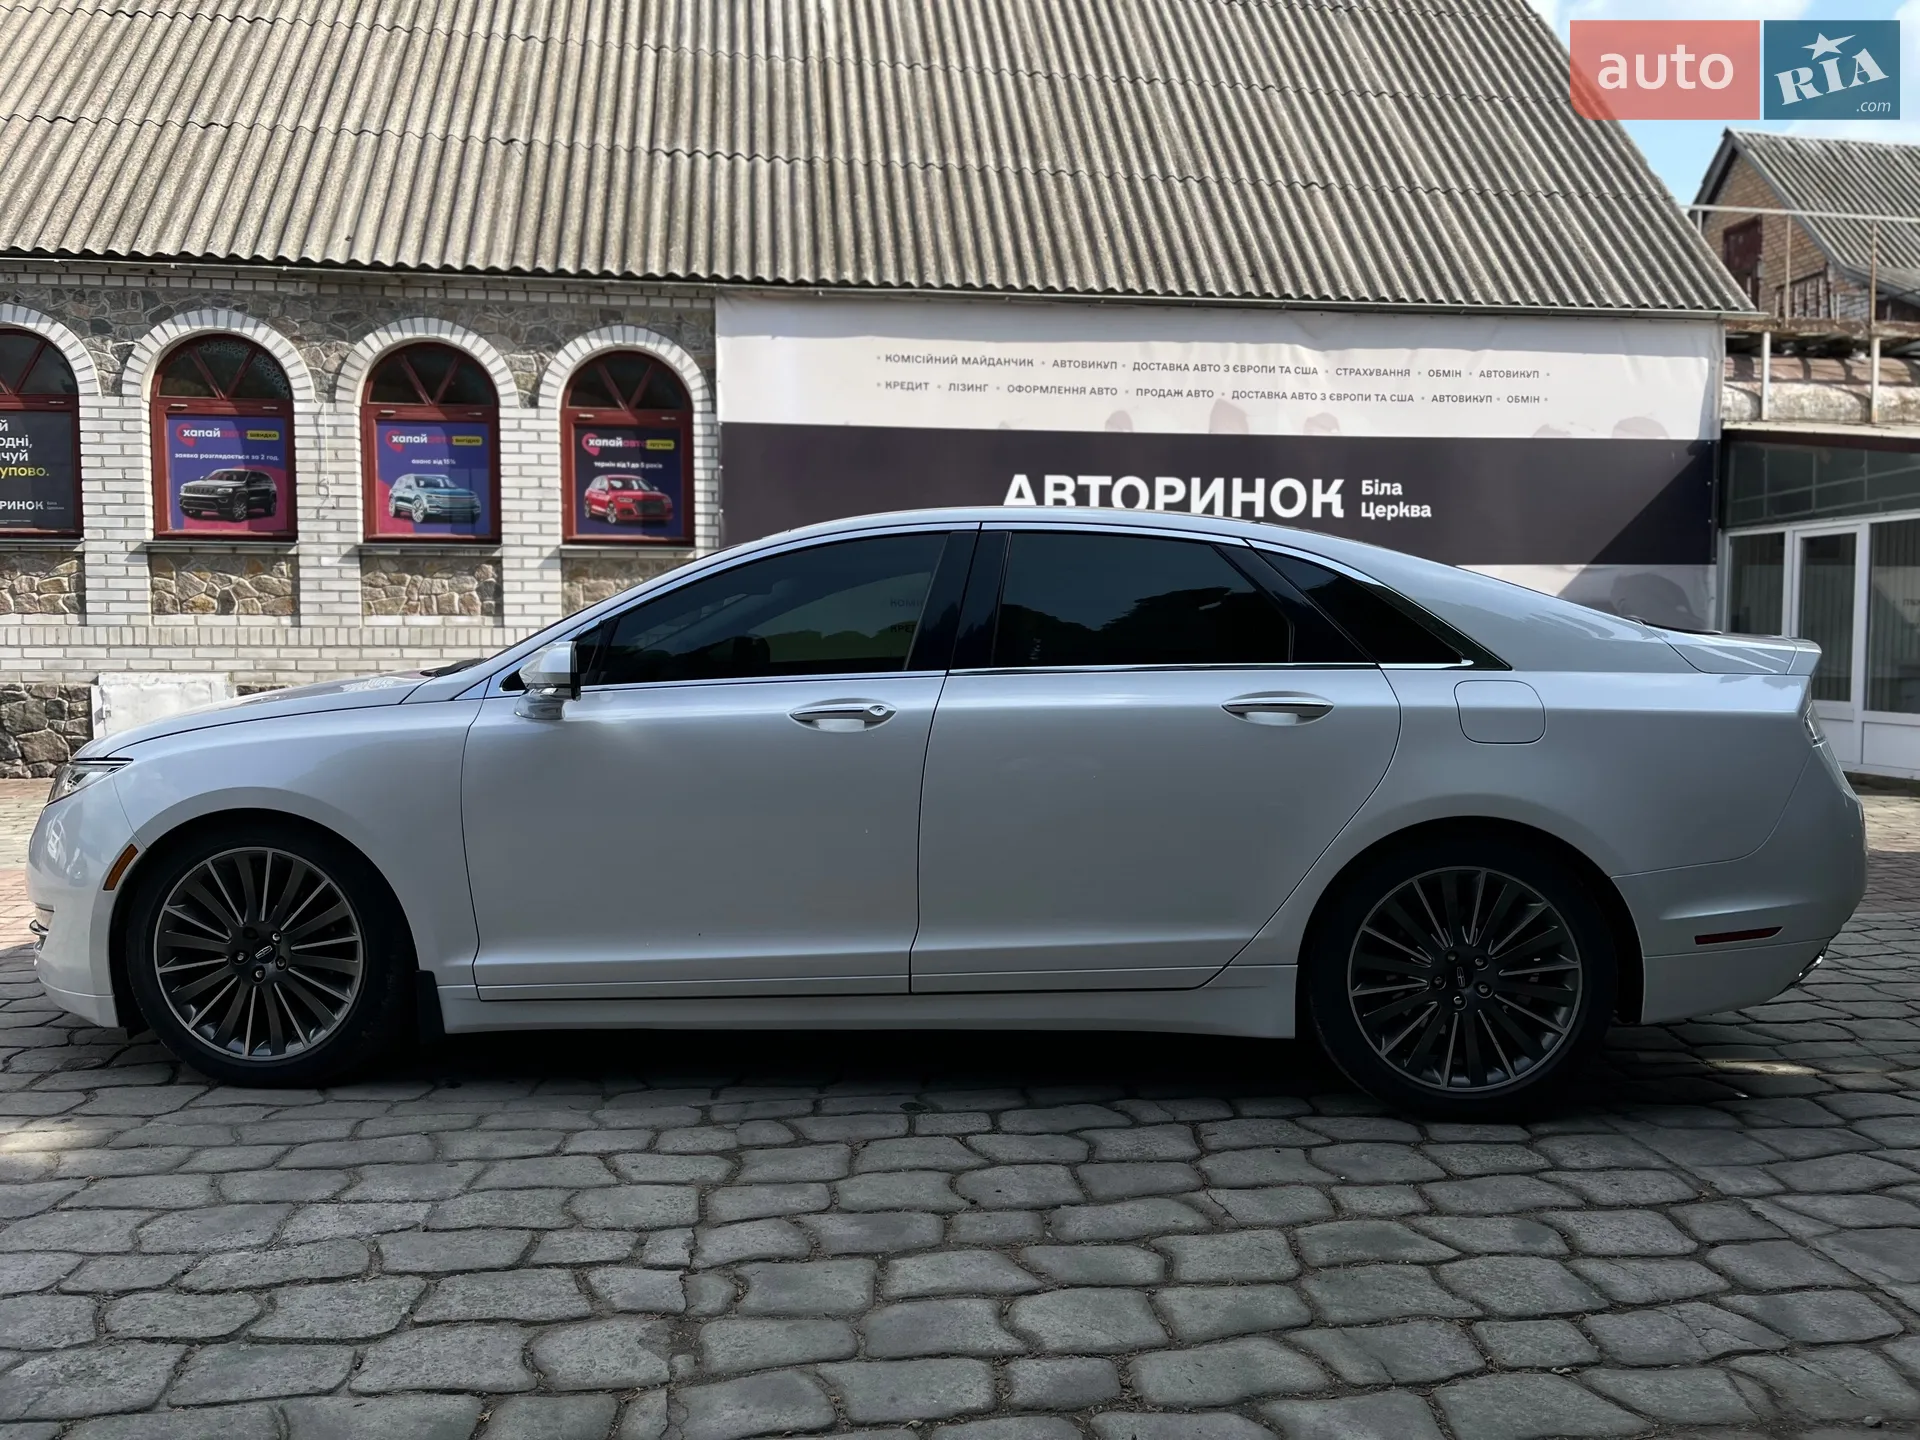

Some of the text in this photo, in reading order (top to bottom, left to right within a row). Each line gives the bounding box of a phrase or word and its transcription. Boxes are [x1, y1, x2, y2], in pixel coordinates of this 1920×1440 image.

[885, 353, 958, 365] КОМІСІЙНИЙ
[961, 355, 1034, 368] МАЙДАНЧИК
[1052, 359, 1118, 370] АВТОВИКУП
[1132, 361, 1190, 372] ДОСТАВКА
[1192, 363, 1221, 373] АВТО
[1232, 364, 1276, 374] ЄВРОПИ
[1278, 365, 1292, 375] ТА
[1294, 366, 1318, 376] США
[1335, 367, 1411, 377] СТРАХУВАННЯ
[1427, 369, 1462, 378] ОБМІН
[1478, 370, 1540, 379] АВТОВИКУП
[885, 380, 930, 391] КРЕДИТ
[948, 383, 989, 393] ЛІЗИНГ
[1007, 384, 1087, 396] ОФОРМЛЕННЯ
[1089, 387, 1118, 396] АВТО
[1135, 388, 1184, 398] ПРОДАЖ
[1186, 389, 1215, 399] АВТО
[1231, 390, 1288, 400] ДОСТАВКА
[1290, 391, 1318, 401] АВТО
[1329, 393, 1372, 402] ЄВРОПИ
[1374, 394, 1388, 402] ТА
[1390, 394, 1415, 403] США
[1431, 394, 1493, 404] АВТОВИКУП
[1506, 395, 1541, 404] ОБМІН
[1003, 474, 1404, 519] АВТОРИНОК Біла
[1361, 502, 1432, 521] Церква
